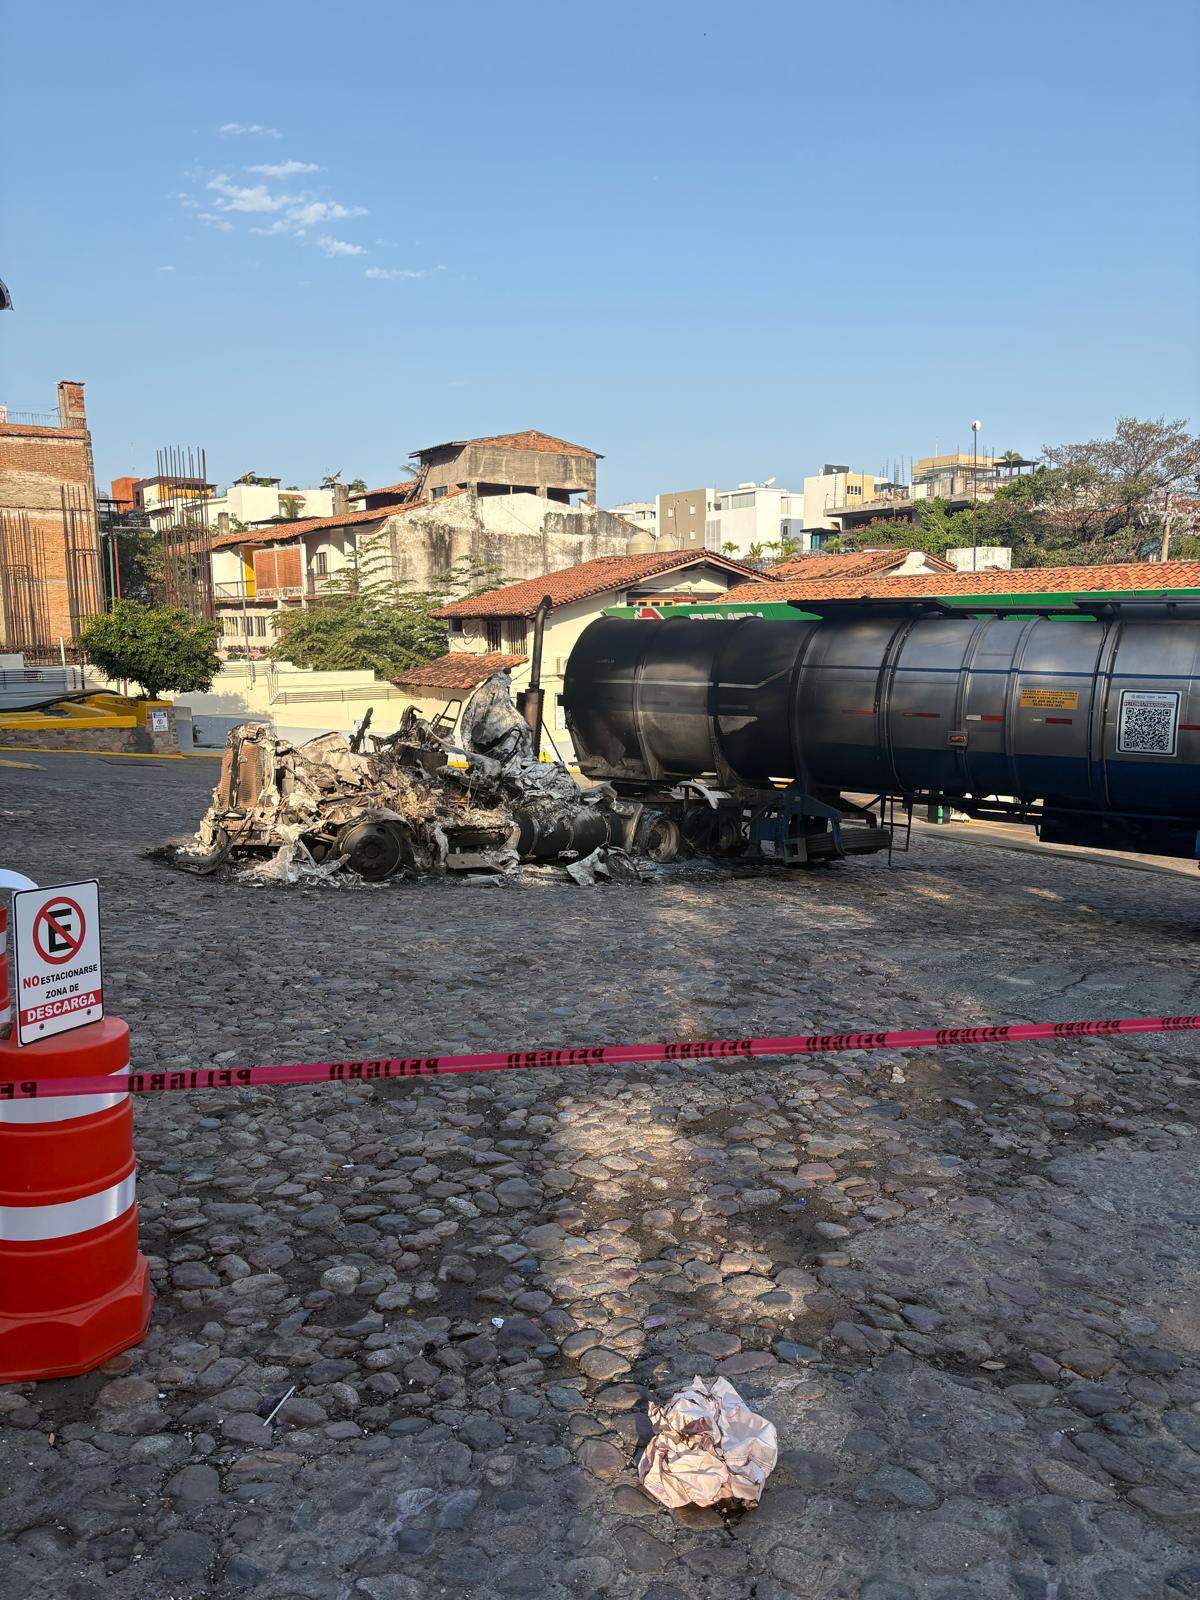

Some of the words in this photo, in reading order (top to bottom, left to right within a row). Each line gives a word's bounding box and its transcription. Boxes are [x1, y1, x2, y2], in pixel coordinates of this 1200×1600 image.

[23, 975, 39, 989] NO
[41, 964, 98, 985] ESTACIONARSE
[46, 986, 67, 999] ZONA
[69, 983, 79, 993] DE
[27, 993, 96, 1022] DESCARGA
